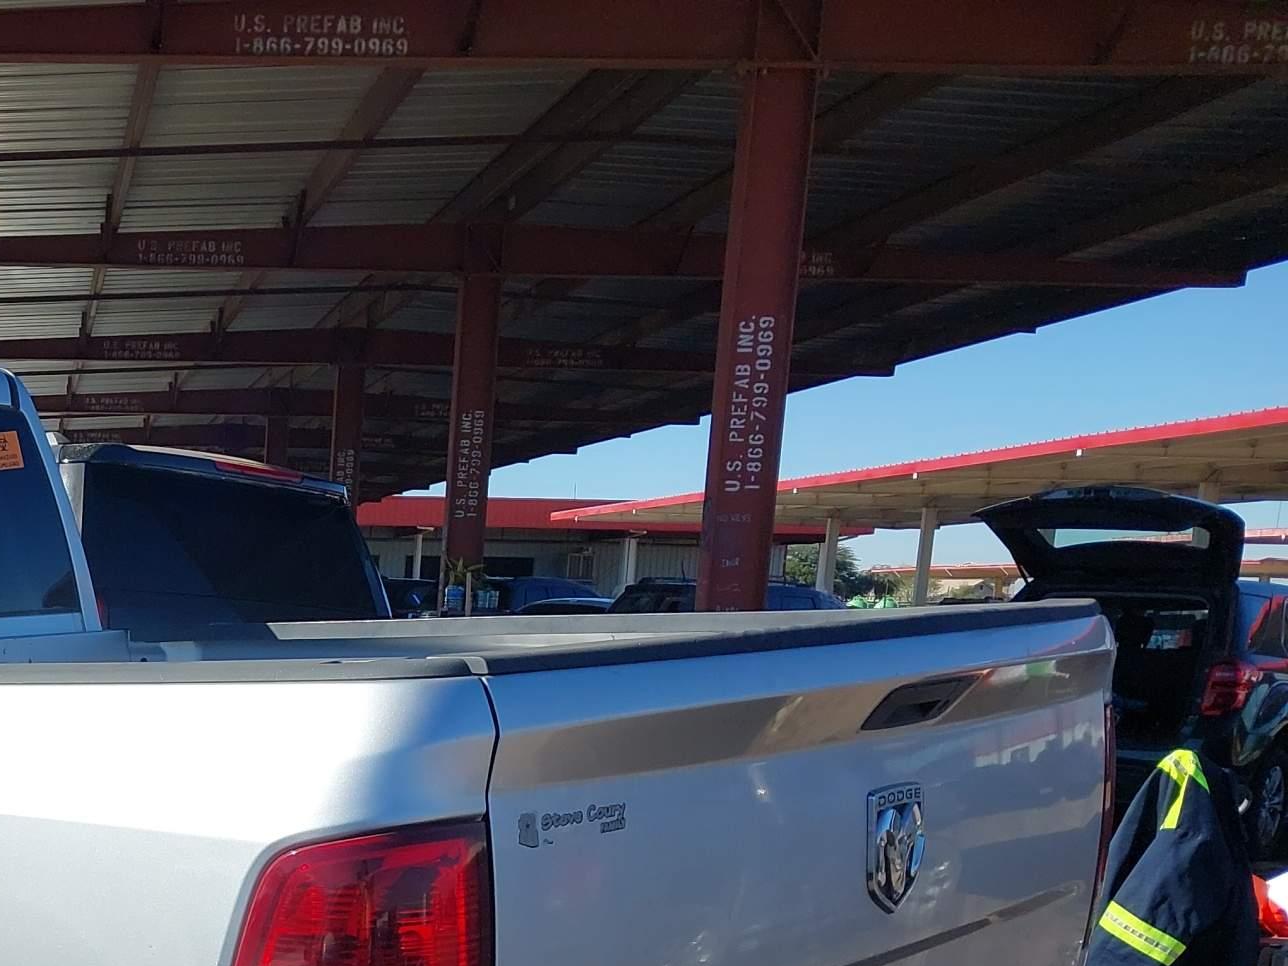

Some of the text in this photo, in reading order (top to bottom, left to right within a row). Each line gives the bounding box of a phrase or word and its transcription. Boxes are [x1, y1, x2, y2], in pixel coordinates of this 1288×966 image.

[234, 14, 271, 33] U.S.
[283, 15, 361, 34] PREFAB
[235, 37, 409, 56] 1-866-799-0969
[725, 314, 756, 493] U.S. PREFAB INC.
[744, 316, 775, 490] 1-866-799-0969
[456, 439, 471, 488] PREFAB
[878, 787, 921, 806] DODGE
[586, 802, 626, 822] Coury
